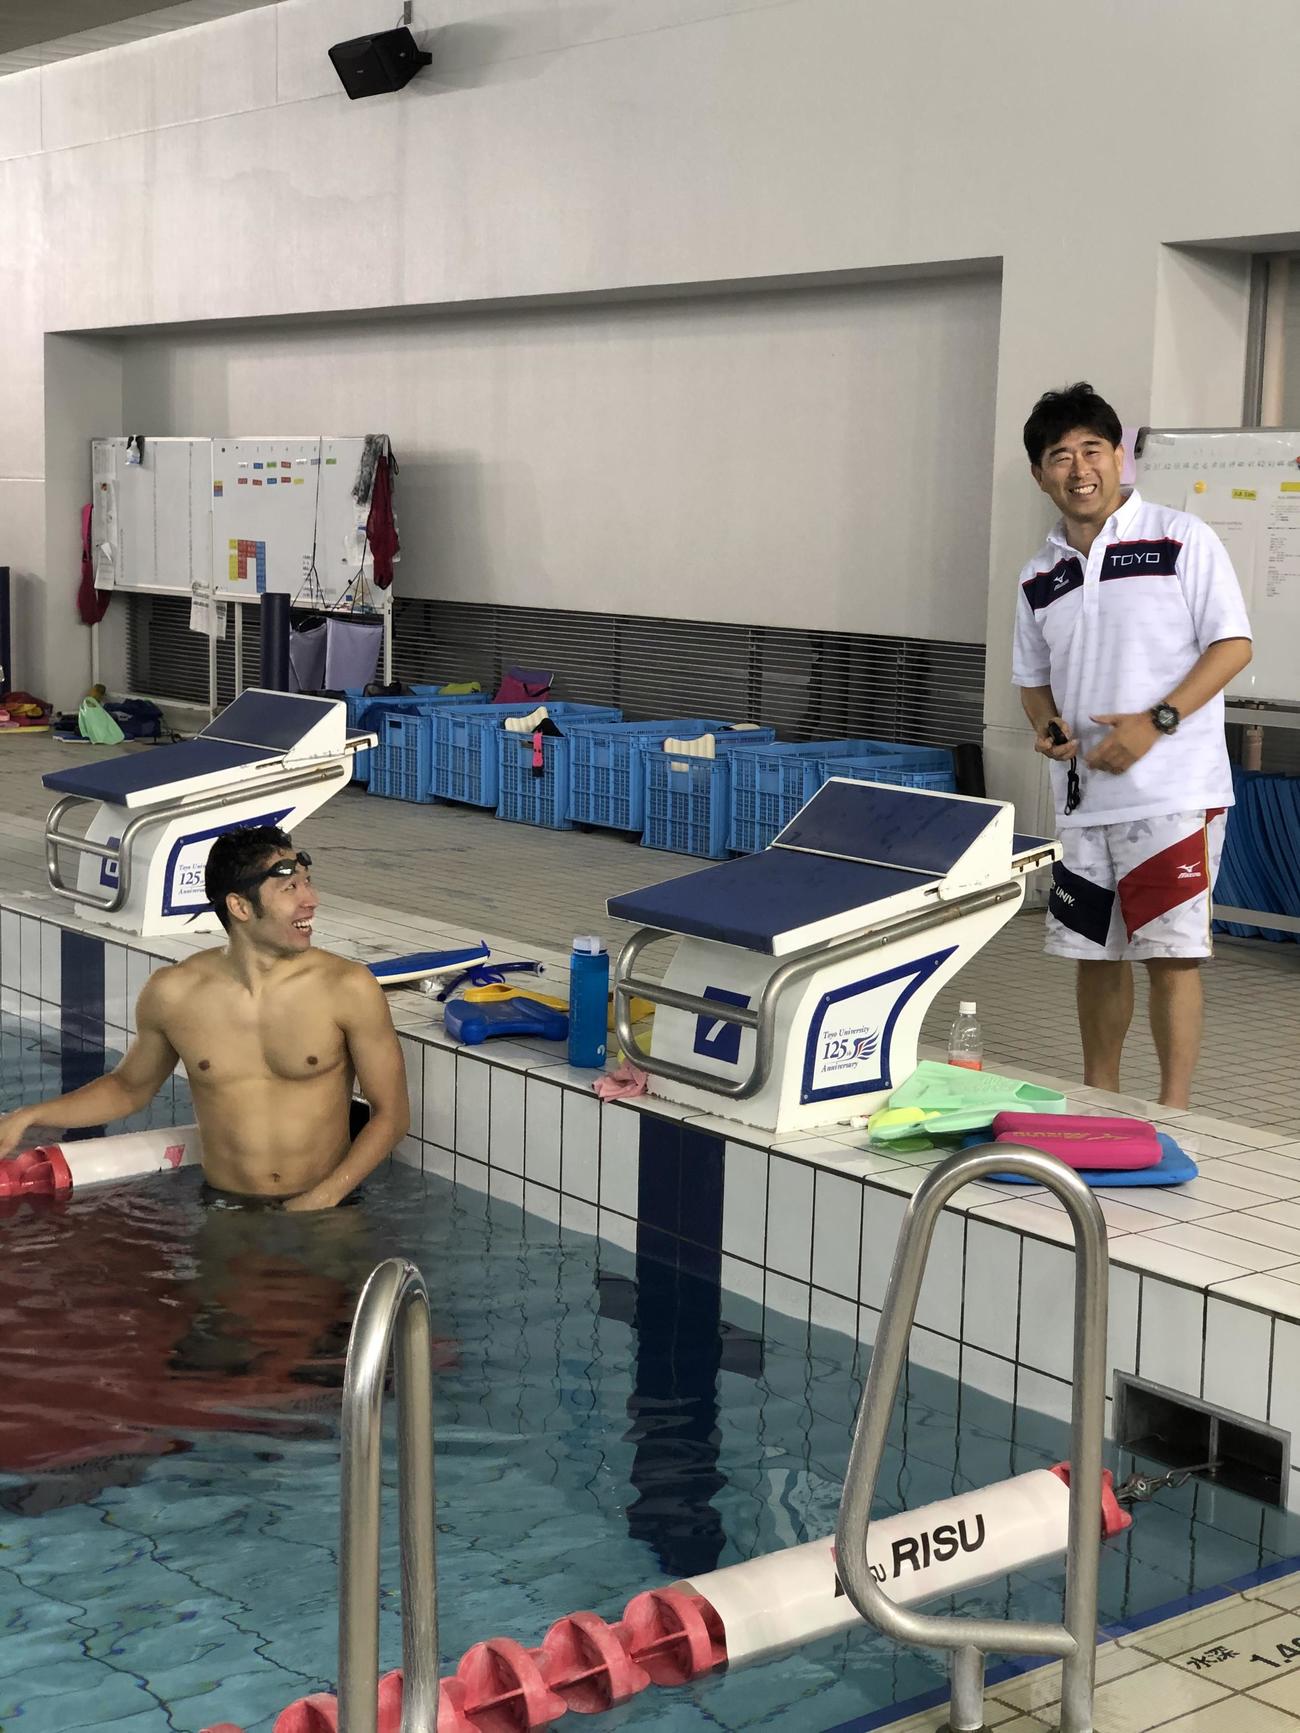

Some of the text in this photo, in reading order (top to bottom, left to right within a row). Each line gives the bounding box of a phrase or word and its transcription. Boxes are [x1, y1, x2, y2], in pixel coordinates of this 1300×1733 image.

[1110, 552, 1161, 567] TOYO
[1056, 886, 1076, 907] UNIV.
[823, 1025, 870, 1040] Toyo University
[821, 1061, 858, 1073] Anniversary
[891, 1513, 985, 1578] RISU
[1186, 1645, 1240, 1670] 水深
